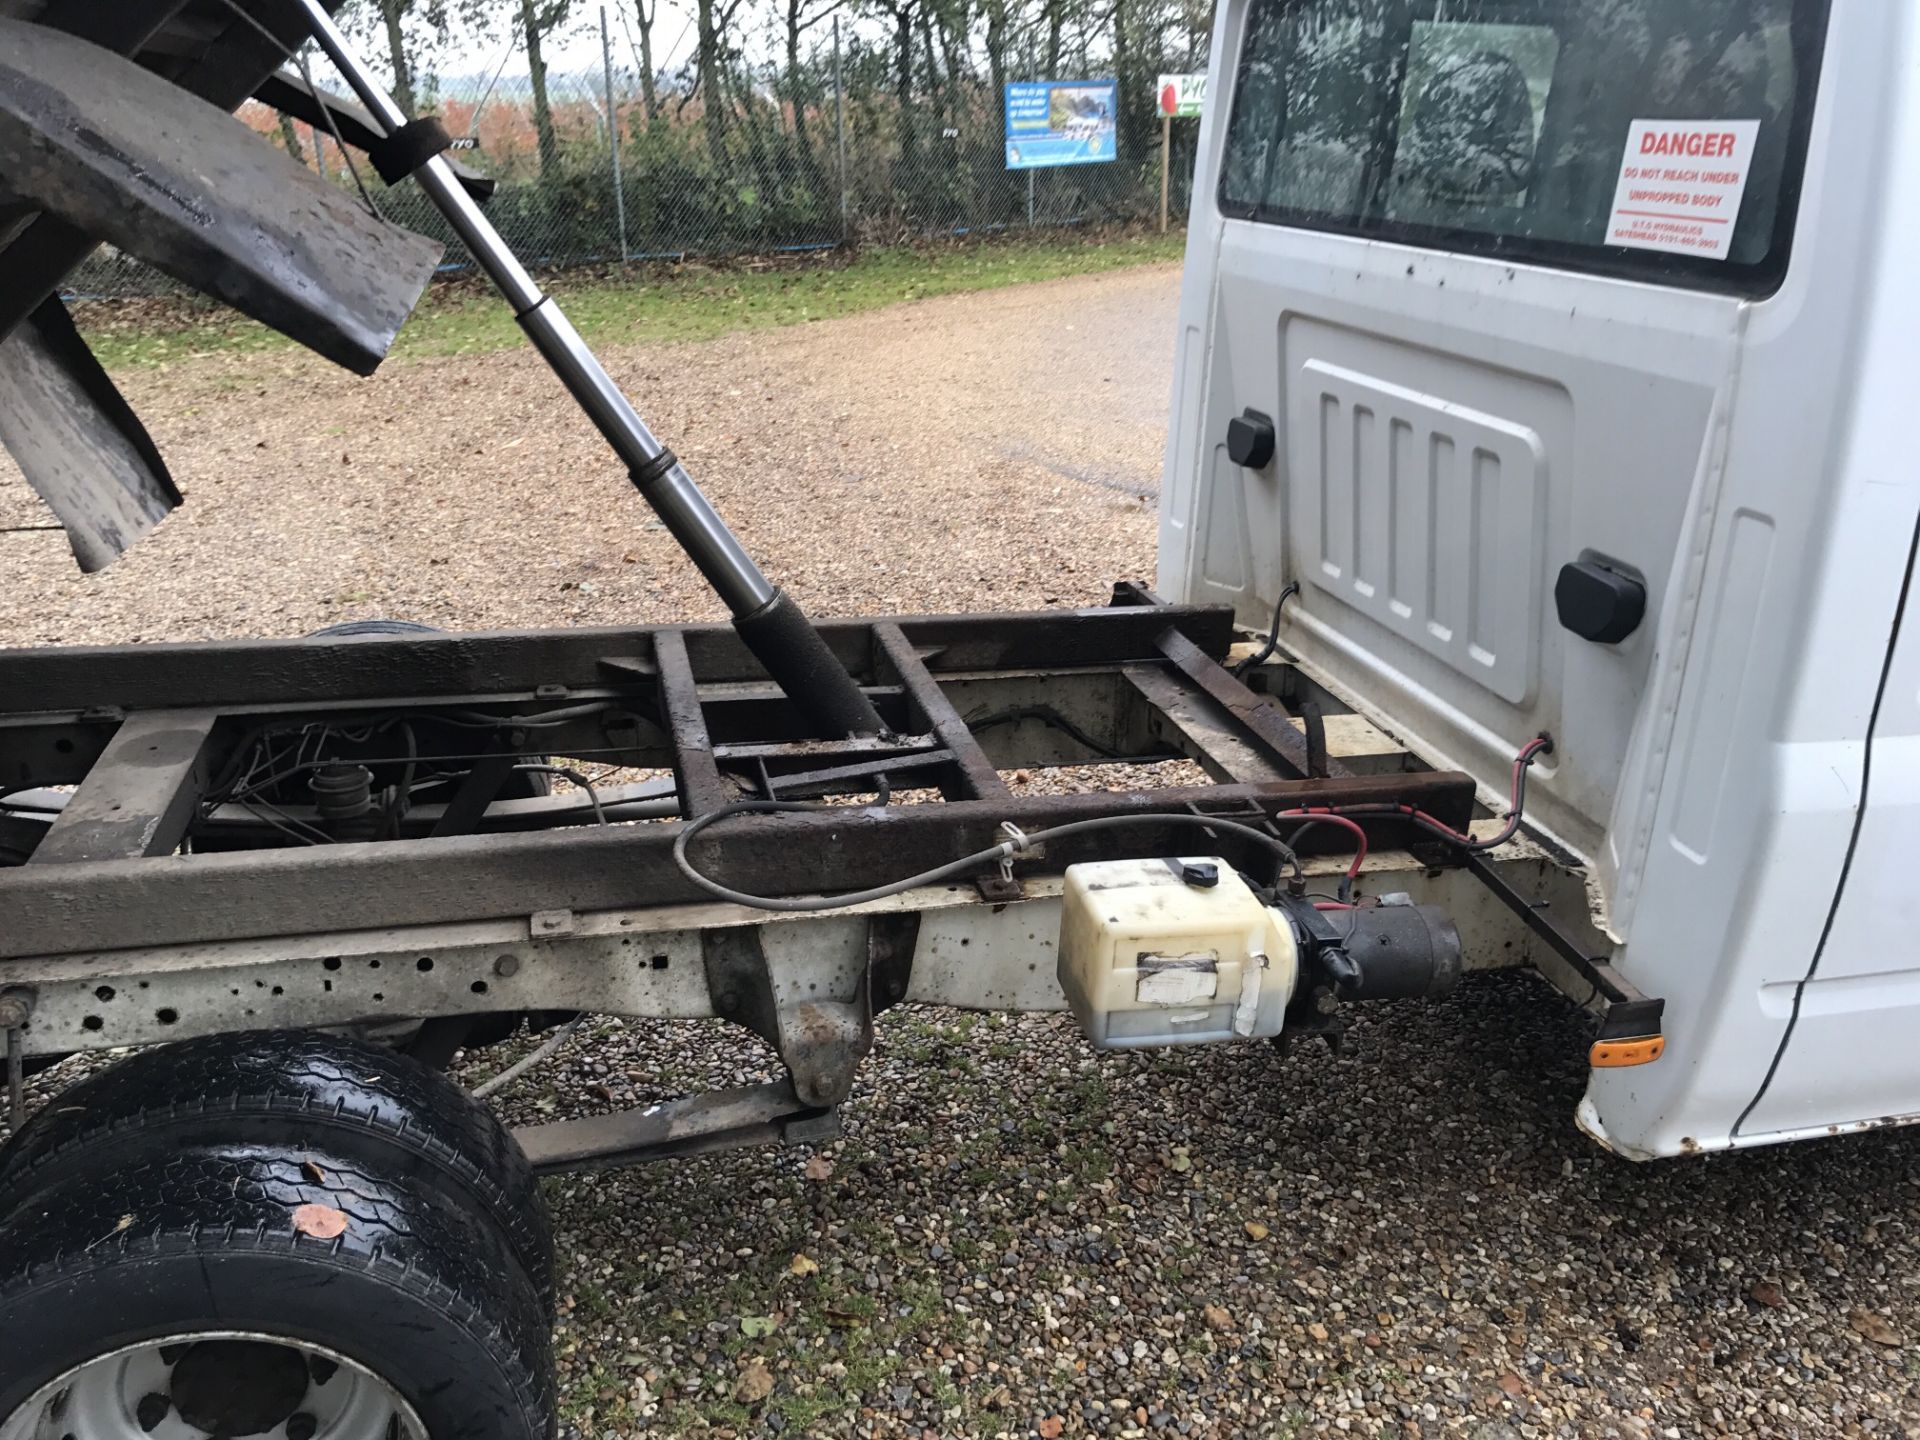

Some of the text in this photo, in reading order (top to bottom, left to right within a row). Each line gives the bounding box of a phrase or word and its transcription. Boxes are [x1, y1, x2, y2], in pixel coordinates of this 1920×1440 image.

[1639, 131, 1737, 157] DANGER
[1624, 167, 1740, 185] DO NOT REACH UNDER
[1629, 190, 1723, 207] UNPROPPED BODY
